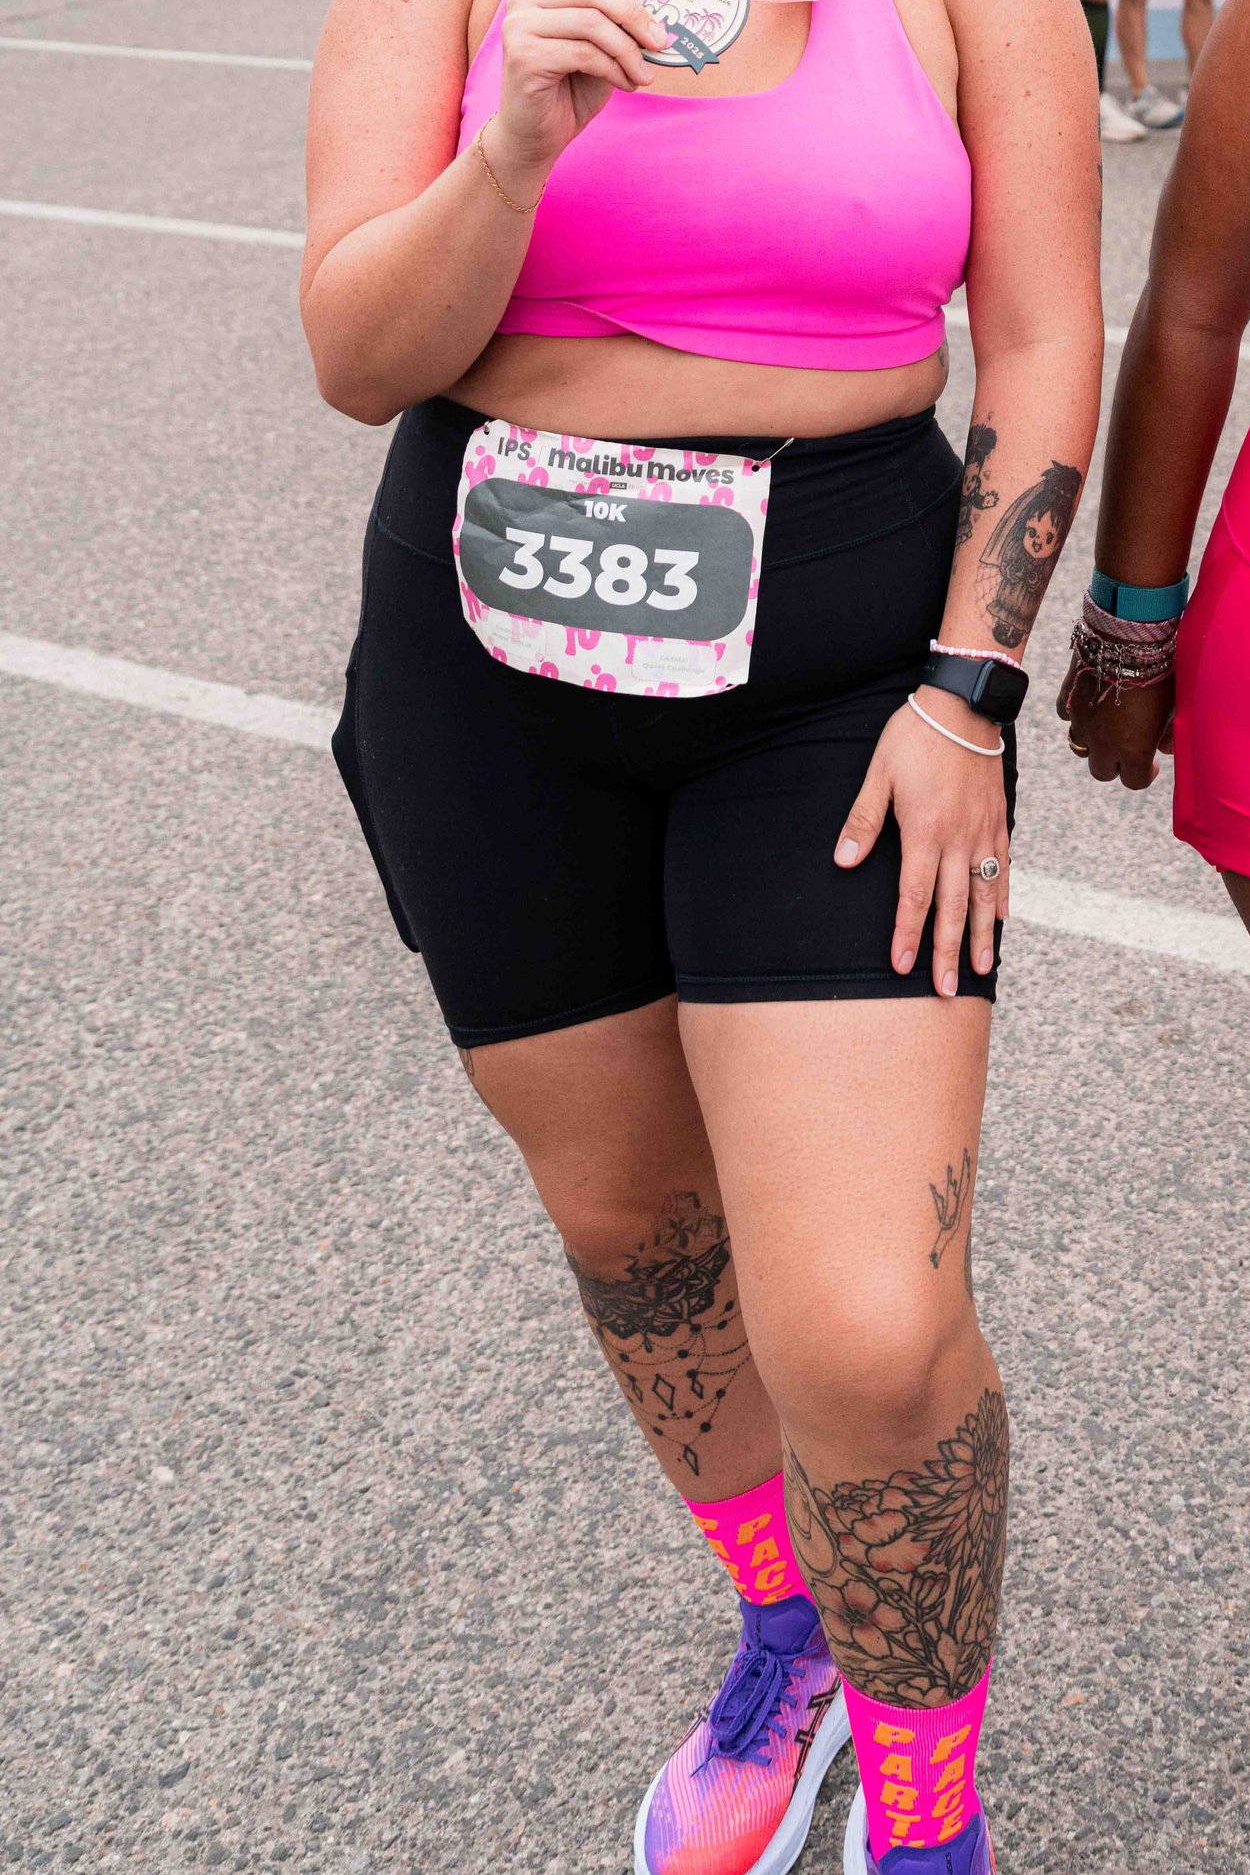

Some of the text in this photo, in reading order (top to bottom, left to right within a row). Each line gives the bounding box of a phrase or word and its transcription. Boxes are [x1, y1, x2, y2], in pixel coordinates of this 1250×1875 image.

[680, 36, 705, 59] 2025
[497, 437, 734, 485] IPS malibu moves
[584, 500, 628, 523] 10K
[498, 527, 700, 611] 3383
[929, 1724, 972, 1843] PACE
